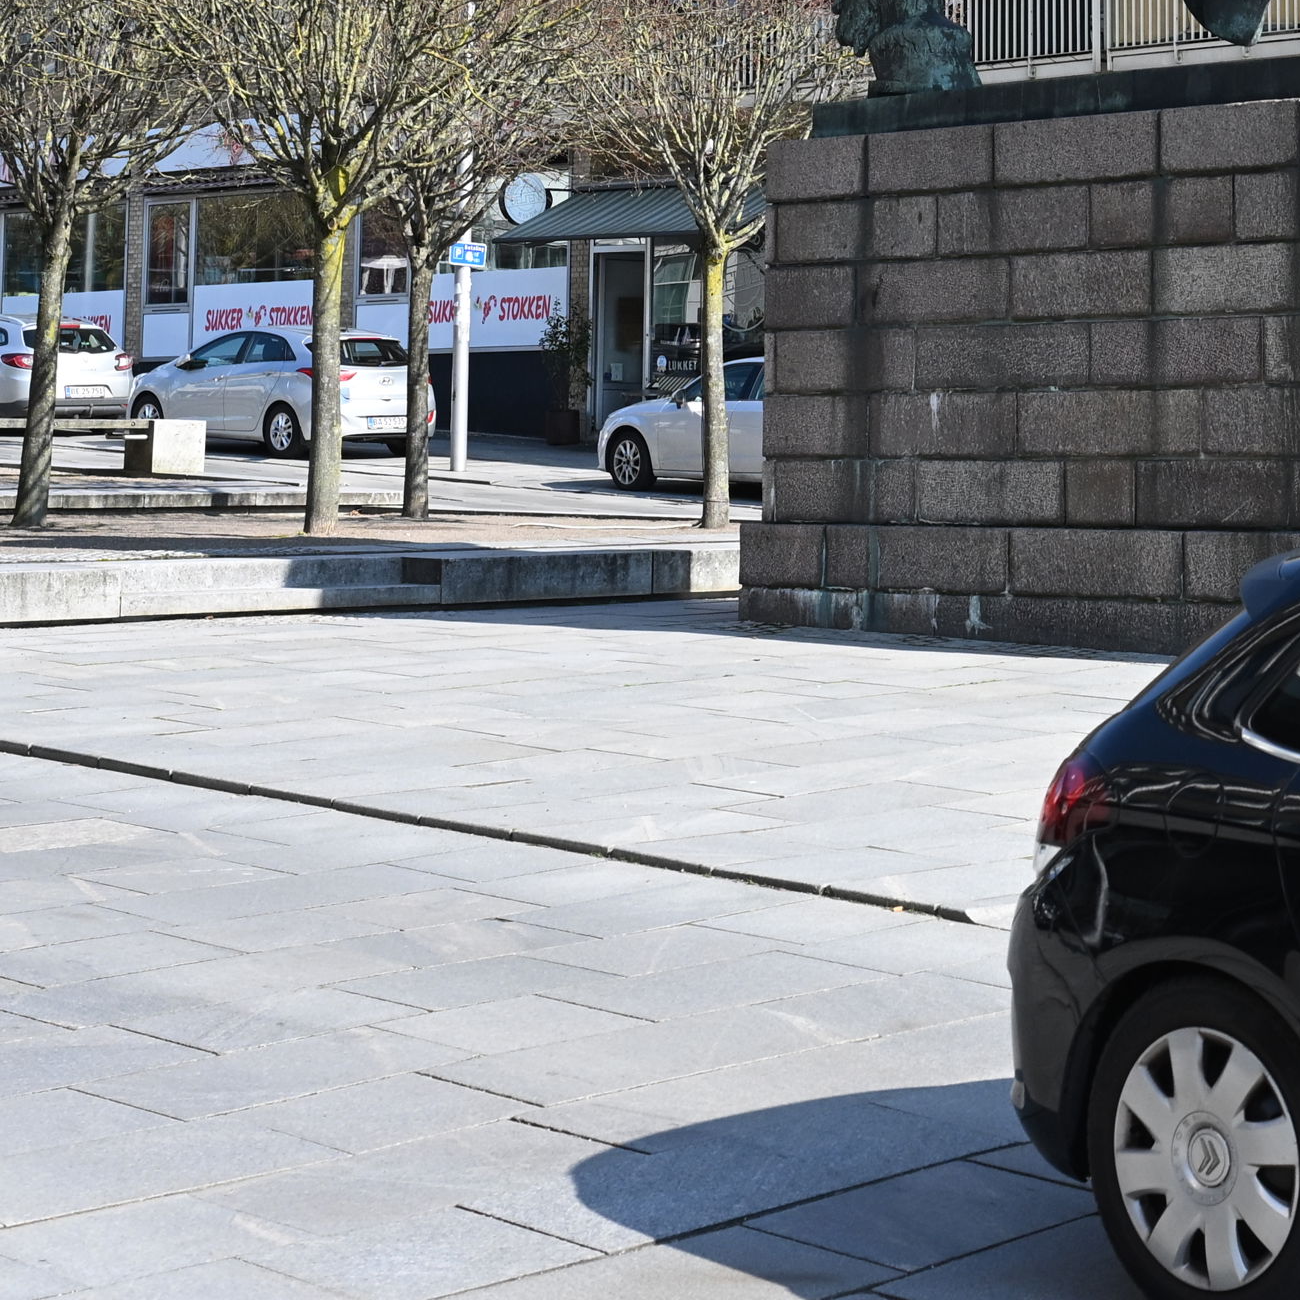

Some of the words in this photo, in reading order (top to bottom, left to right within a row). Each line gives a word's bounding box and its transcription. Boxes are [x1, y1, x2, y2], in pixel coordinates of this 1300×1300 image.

[205, 308, 243, 332] SUKKER
[268, 305, 314, 327] STOKKEN
[427, 300, 455, 325] SUKK
[498, 295, 551, 322] STOKKEN
[668, 360, 698, 371] LUKKET
